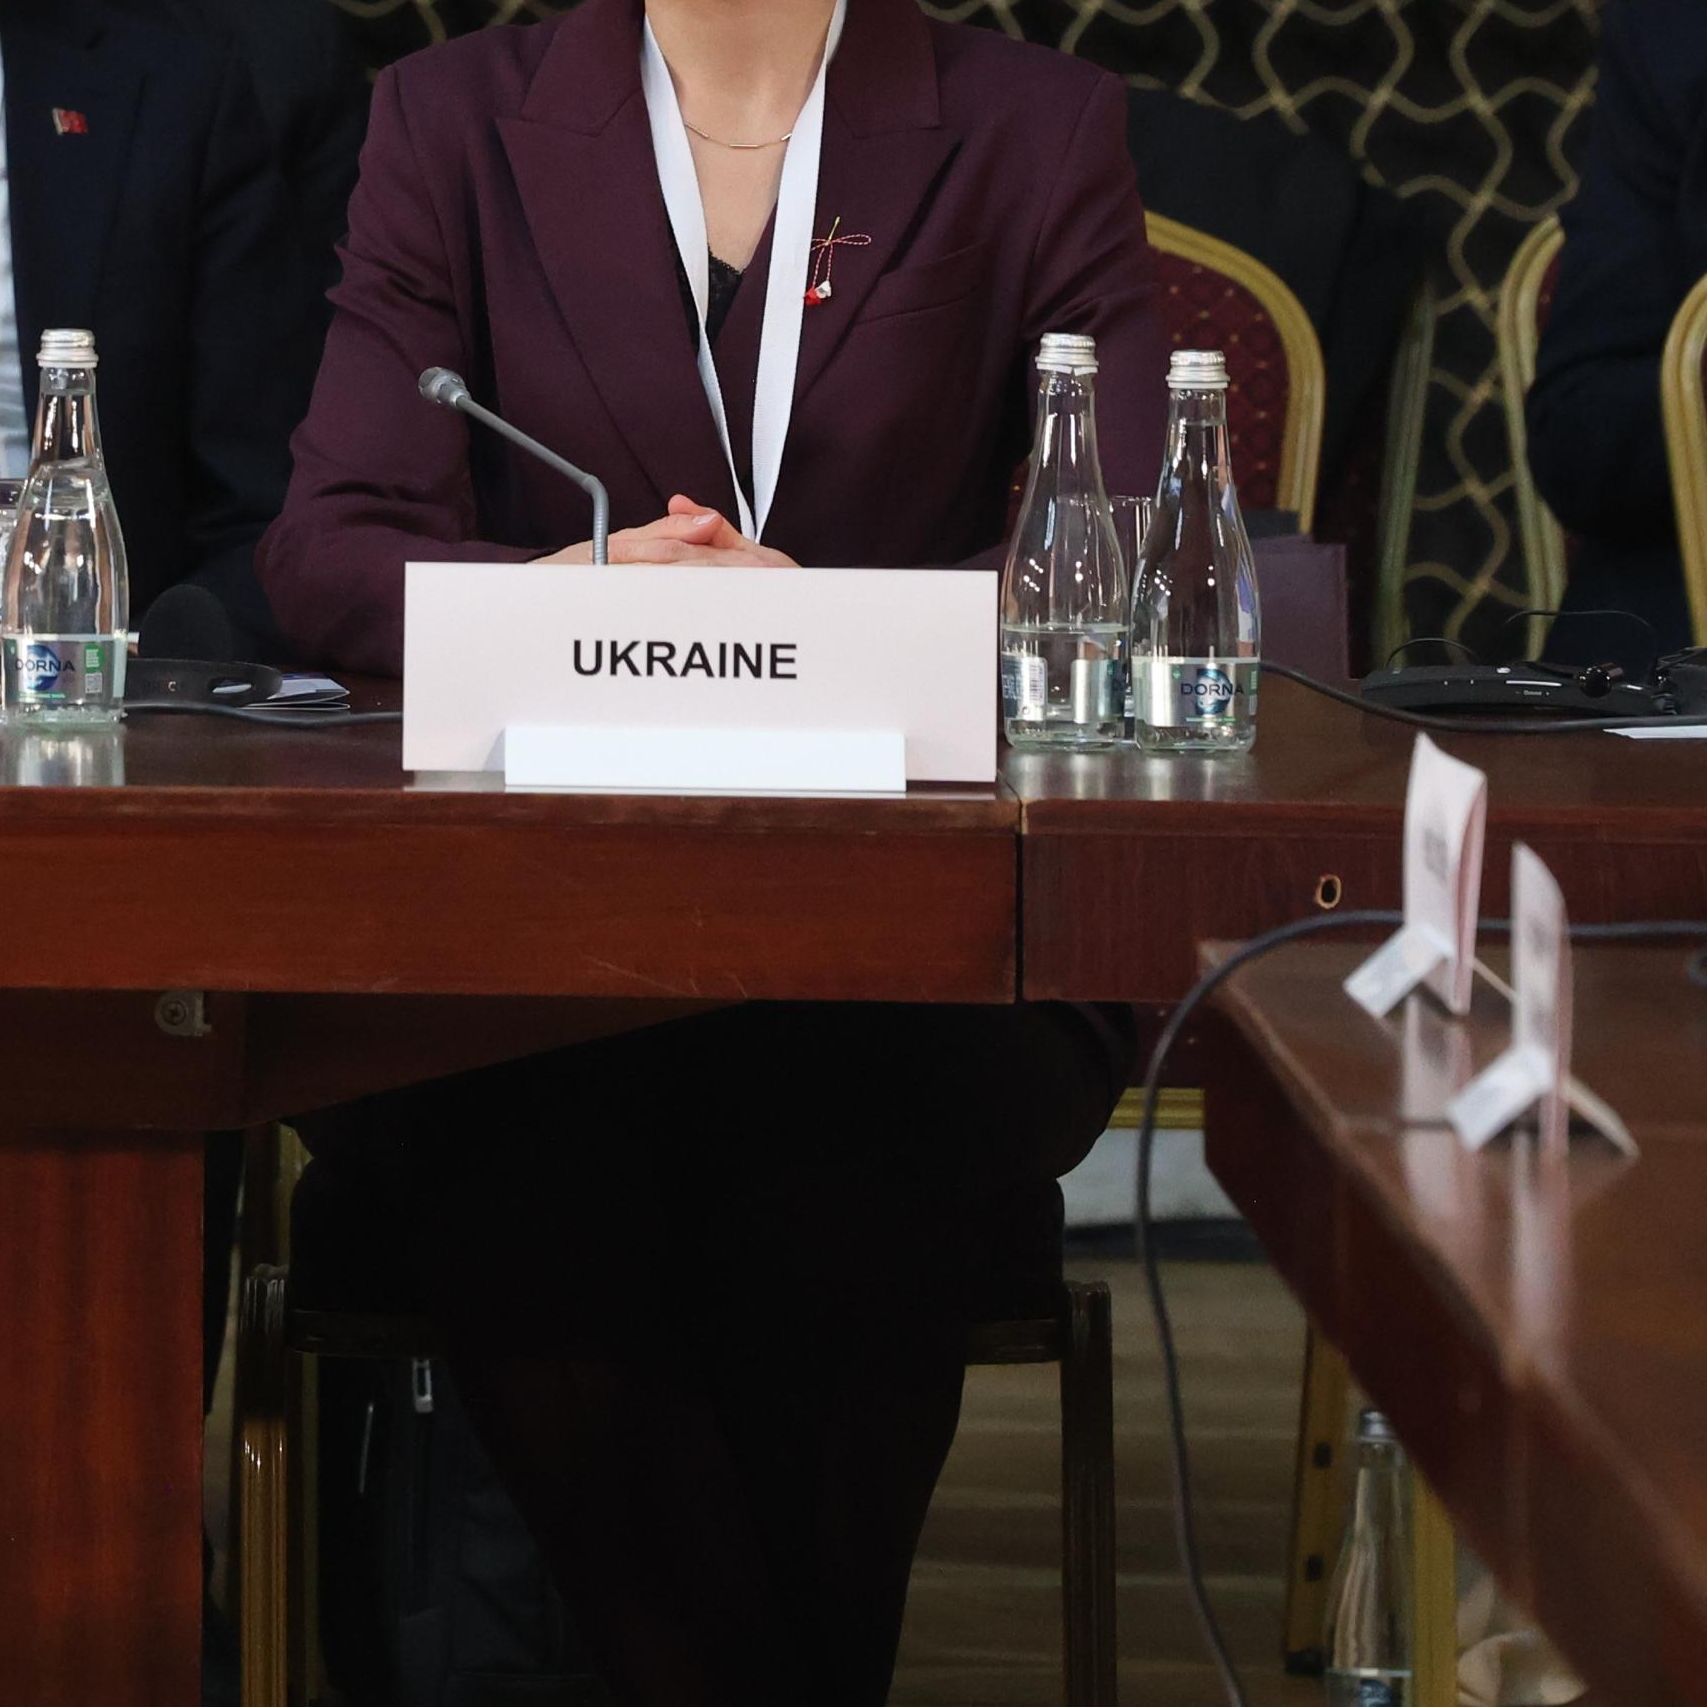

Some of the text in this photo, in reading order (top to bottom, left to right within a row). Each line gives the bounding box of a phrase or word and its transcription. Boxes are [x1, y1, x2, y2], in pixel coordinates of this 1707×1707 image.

[15, 658, 76, 672] DORNA
[572, 638, 798, 681] UKRAINE
[1180, 682, 1245, 696] DORNA
